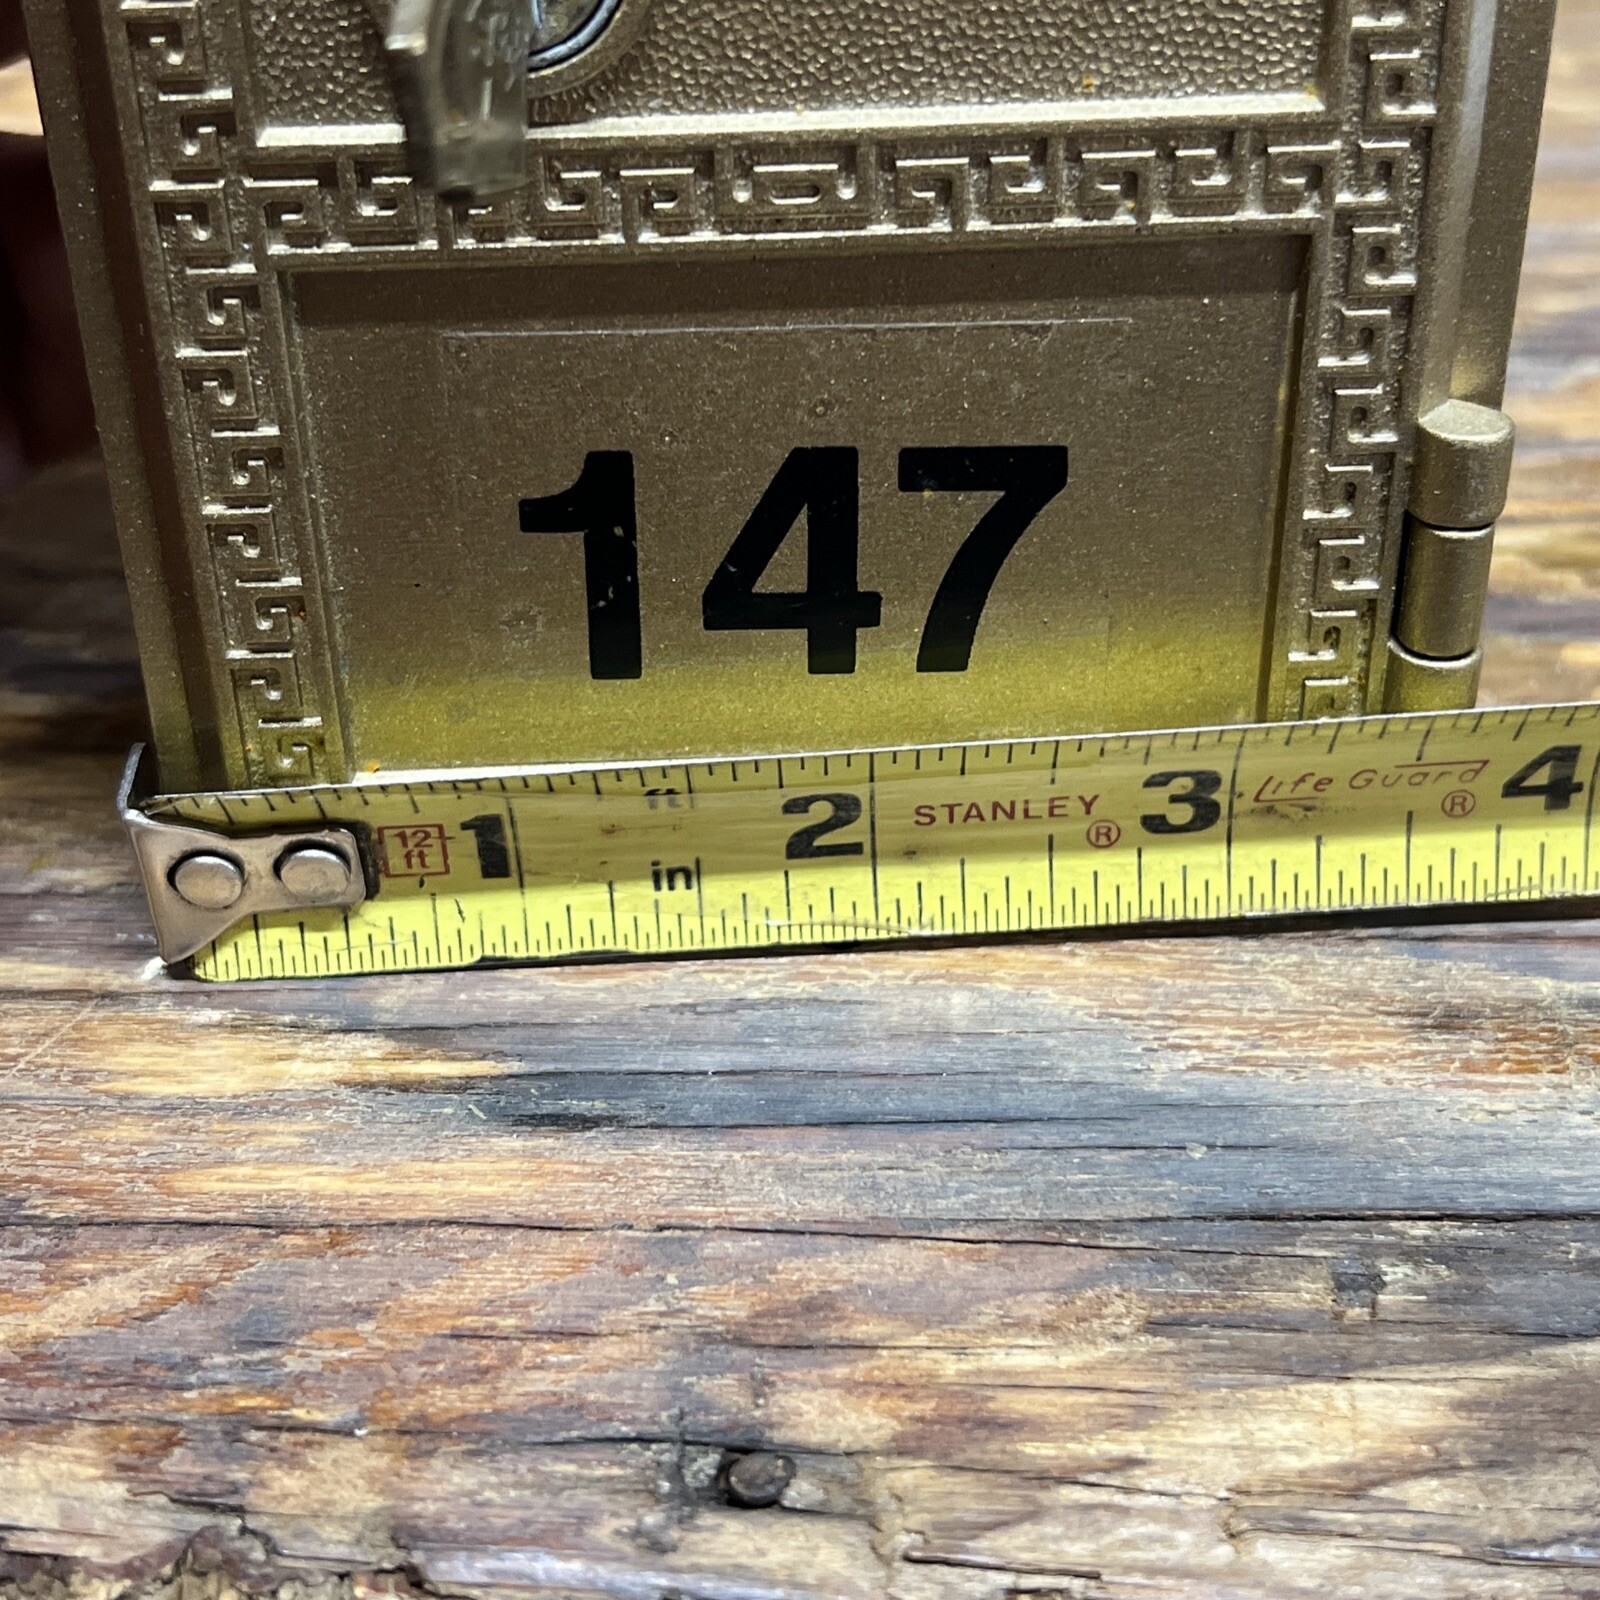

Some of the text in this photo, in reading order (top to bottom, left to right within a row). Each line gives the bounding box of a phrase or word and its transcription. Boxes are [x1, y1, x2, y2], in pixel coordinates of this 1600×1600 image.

[518, 445, 1068, 680] 147
[645, 787, 682, 811] ft
[1254, 759, 1489, 804] Life Guard
[1500, 745, 1583, 810] 4
[914, 794, 1099, 826] STANLEY
[1140, 769, 1222, 834] 3
[399, 829, 433, 850] 12
[460, 813, 511, 879] 1
[782, 792, 864, 860] 2
[404, 848, 432, 871] ft
[651, 860, 693, 892] in
